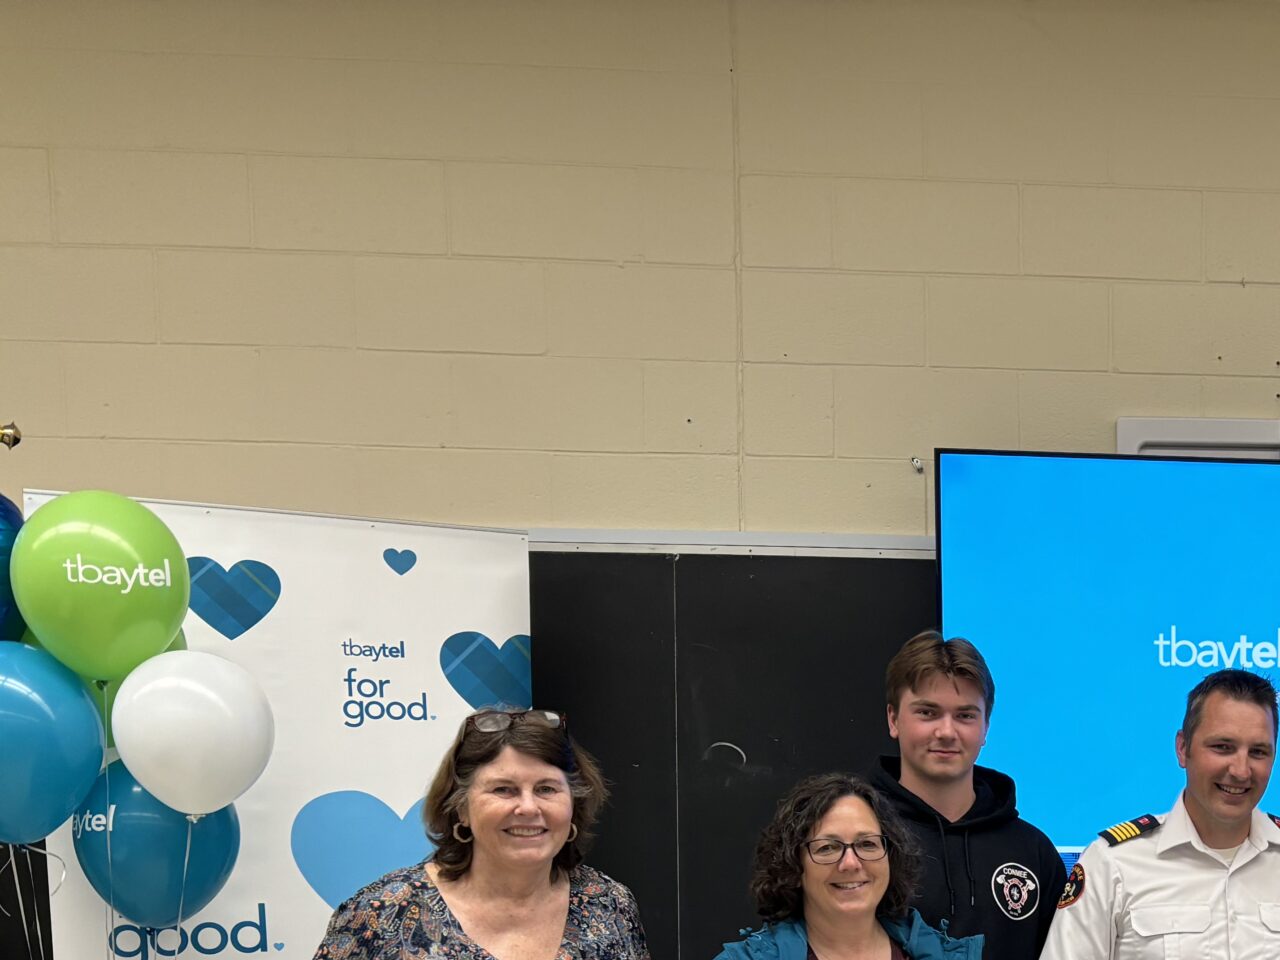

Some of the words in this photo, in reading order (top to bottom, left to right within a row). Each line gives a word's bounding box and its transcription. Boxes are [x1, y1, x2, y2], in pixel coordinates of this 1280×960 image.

[62, 553, 172, 594] tbaytel
[341, 638, 405, 662] tbaytel
[343, 667, 390, 698] for
